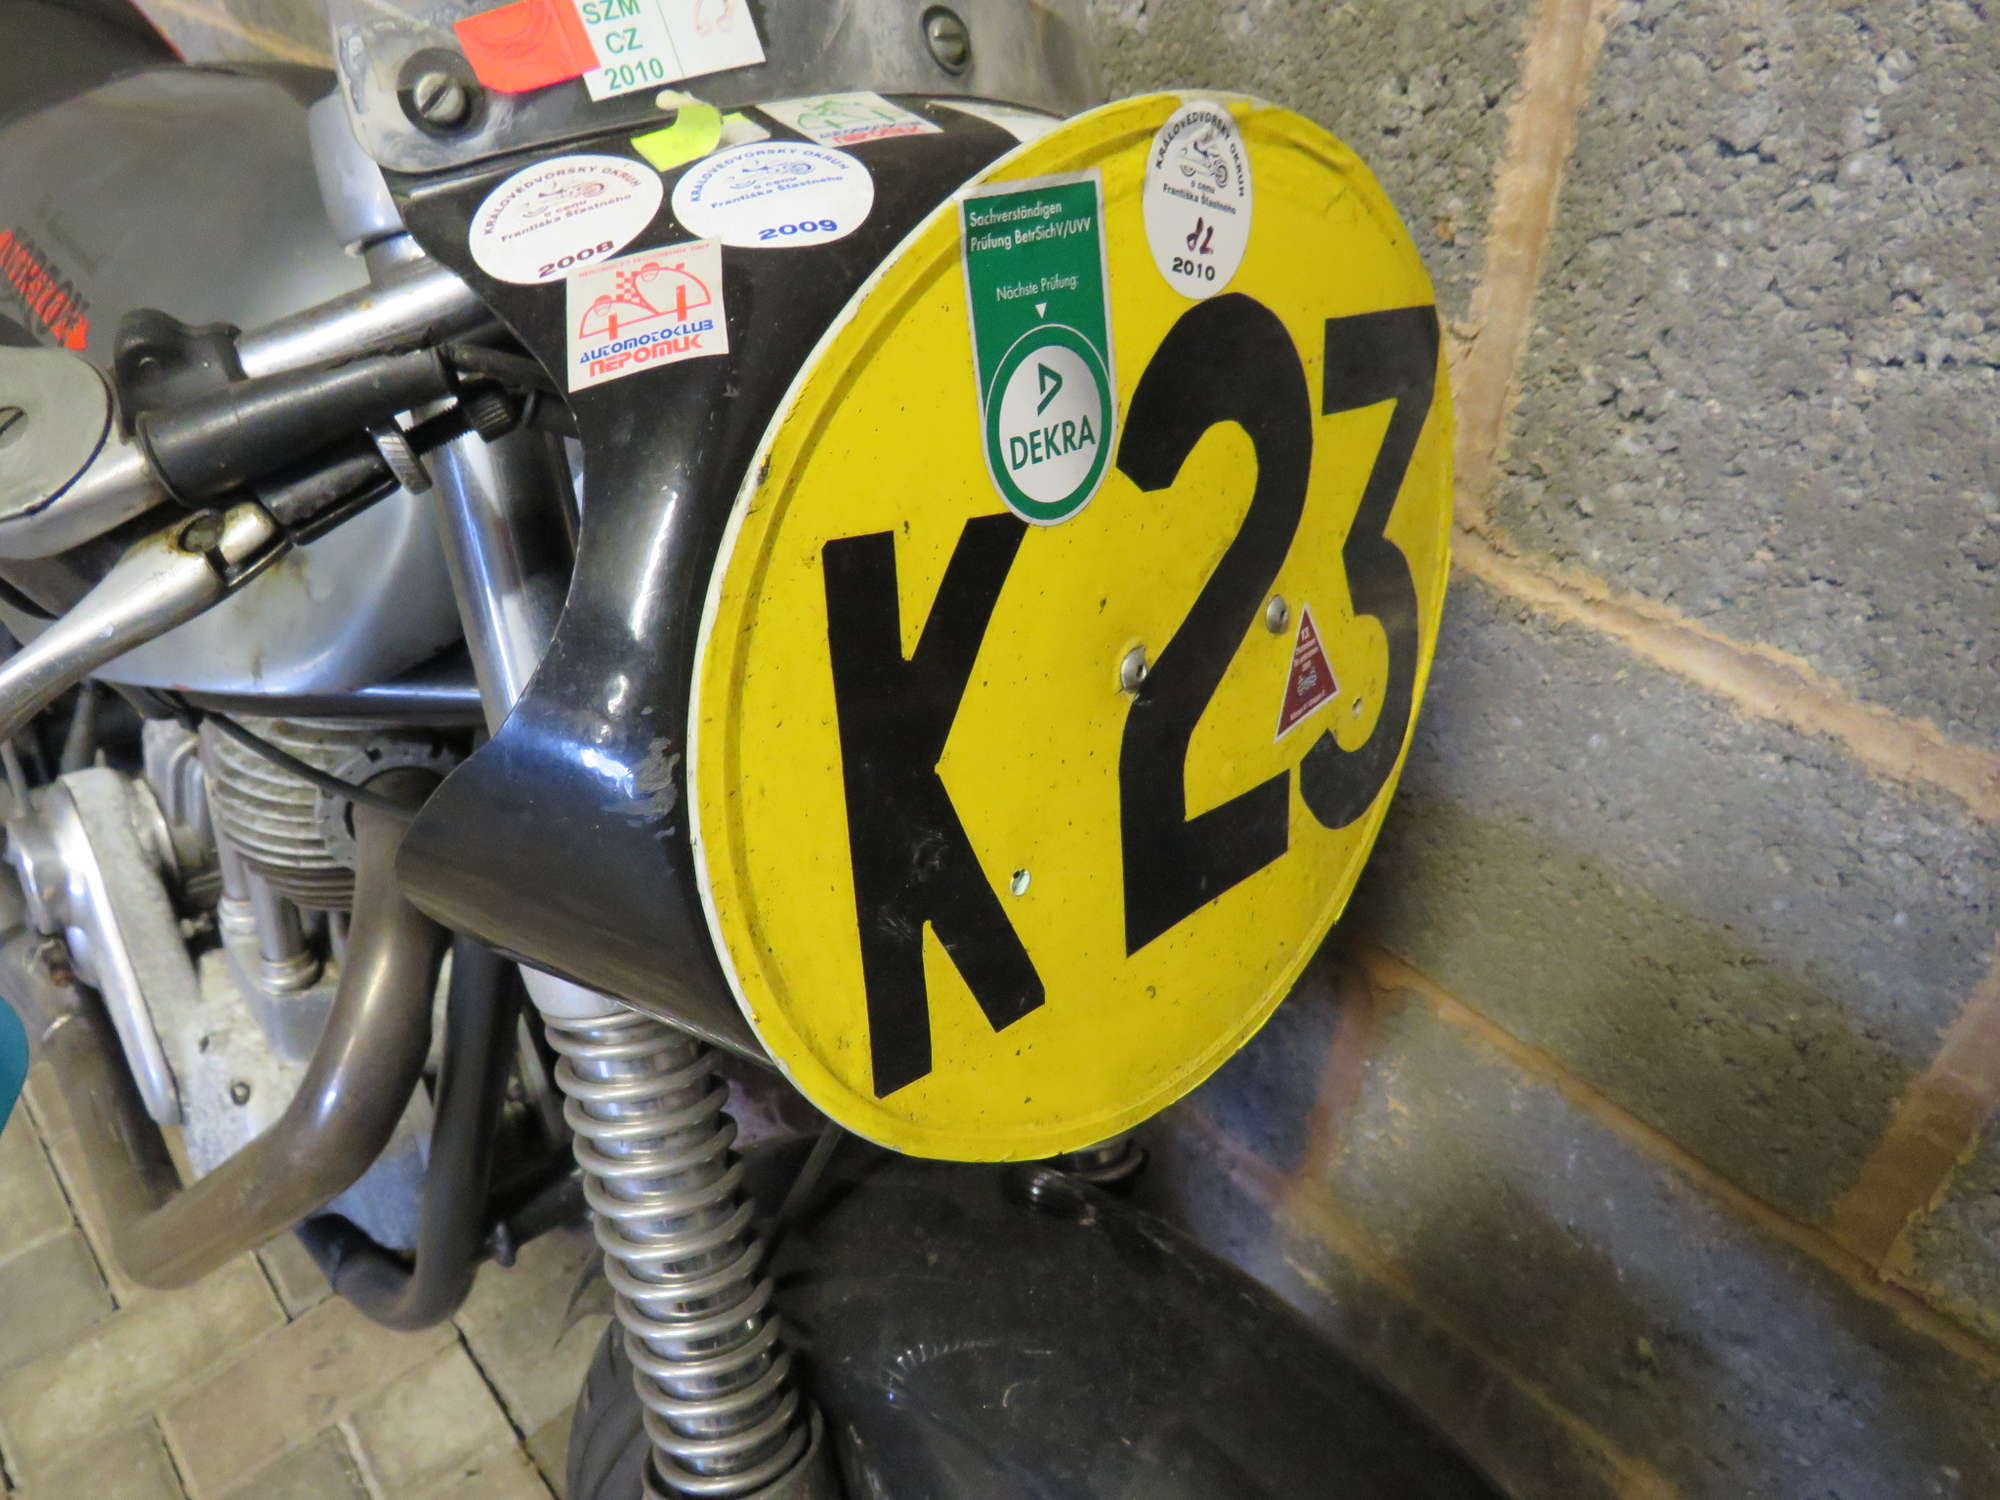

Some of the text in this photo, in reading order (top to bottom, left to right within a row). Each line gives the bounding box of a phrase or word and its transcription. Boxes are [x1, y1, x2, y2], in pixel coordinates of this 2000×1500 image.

[582, 0, 641, 25] SZM
[605, 27, 643, 54] CZ
[604, 57, 664, 91] 2010
[969, 200, 1063, 228] Sachverständigen
[758, 219, 838, 242] 2009
[970, 216, 1091, 253] Prüfung BetrSichV/UVV
[538, 240, 615, 279] 2008
[1172, 256, 1216, 281] 2010
[996, 280, 1039, 301] Nächste
[579, 319, 714, 364] AUTOMOTOKLUB
[589, 333, 704, 377] NEPOMUK
[1009, 413, 1098, 472] DEKRA
